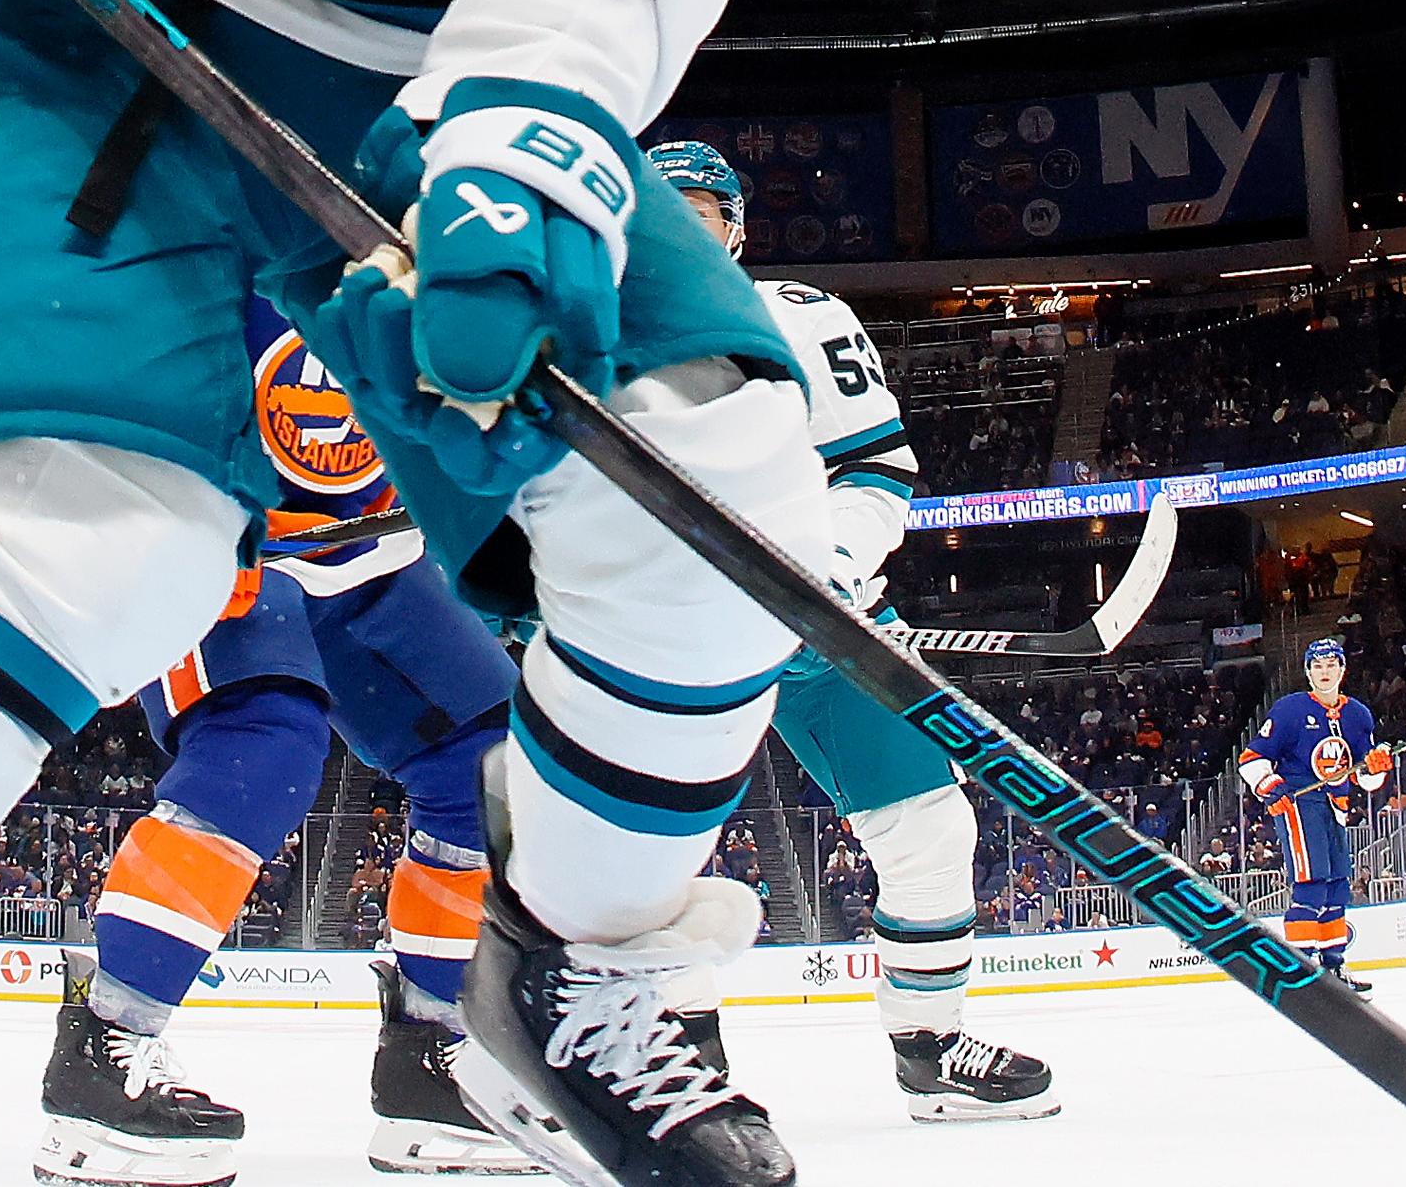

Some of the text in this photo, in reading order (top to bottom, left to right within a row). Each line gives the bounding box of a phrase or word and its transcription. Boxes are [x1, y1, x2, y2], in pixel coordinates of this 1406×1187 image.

[1220, 469, 1326, 495] WINNING TICKET:
[944, 497, 964, 507] FOR
[981, 951, 1083, 975] Heineken
[228, 967, 332, 984] VANDA
